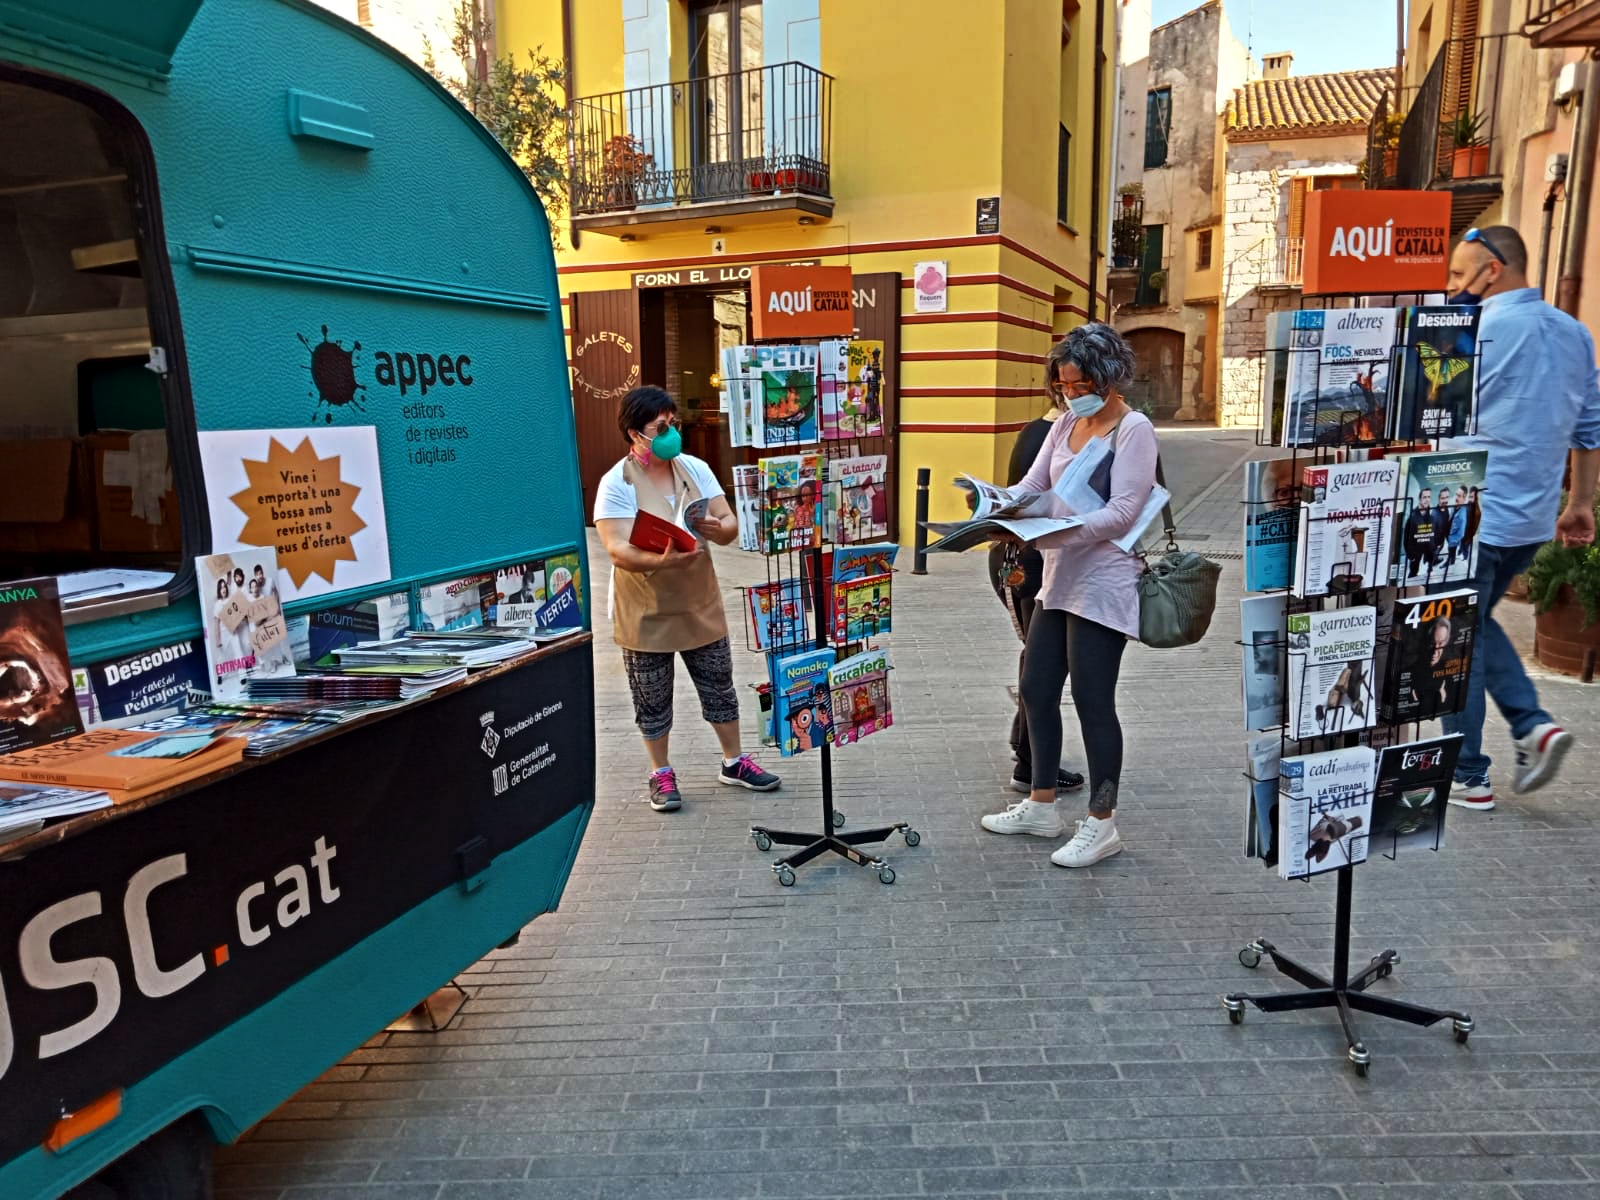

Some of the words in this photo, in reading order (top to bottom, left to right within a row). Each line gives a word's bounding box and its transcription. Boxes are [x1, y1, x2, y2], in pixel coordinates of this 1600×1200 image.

[715, 241, 722, 252] 4
[1329, 218, 1394, 262] AQUÍ
[1395, 227, 1432, 237] REVISTES
[1435, 227, 1445, 237] EN
[1395, 238, 1445, 256] CATALÀ
[635, 272, 680, 287] FORN
[690, 270, 709, 283] EL
[768, 285, 812, 316] AQUÍ
[841, 290, 848, 298] EN
[814, 298, 849, 312] CATALÀ
[1311, 316, 1322, 327] 24
[1337, 312, 1384, 330] alberes
[1417, 312, 1474, 327] Descobrir
[576, 331, 633, 356] GALETES
[374, 351, 473, 396] appec
[572, 364, 640, 399] ARTESANES
[403, 402, 445, 419] editors
[406, 425, 420, 442] de
[424, 424, 469, 440] revistes
[408, 448, 412, 464] i
[415, 446, 456, 467] digitals
[280, 470, 309, 484] Vine
[312, 469, 316, 482] i
[843, 466, 850, 475] el
[852, 462, 881, 473] tatano
[1427, 461, 1472, 474] ENDERROCK
[1314, 474, 1326, 485] 38
[1330, 470, 1395, 493] gavarres
[257, 485, 317, 508] emporta't
[320, 488, 341, 498] una
[271, 506, 305, 520] bossa
[308, 500, 332, 516] amb
[276, 521, 322, 537] revistes
[326, 522, 332, 530] a
[277, 543, 298, 554] eus
[302, 534, 347, 550] d'oferta
[504, 605, 533, 623] alberes
[540, 588, 573, 627] VERTEX
[1405, 598, 1452, 629] 440
[1298, 621, 1308, 631] 26
[1318, 614, 1374, 637] garrotxes
[104, 641, 193, 686] Descobrir
[787, 661, 828, 679] Namaka
[124, 679, 193, 716] Pedraforca
[504, 714, 534, 738] Diputació
[534, 711, 543, 723] de
[542, 701, 564, 717] Girona
[509, 742, 550, 773] Generalitat
[1290, 767, 1302, 776] 29
[1309, 758, 1338, 777] cadí
[511, 774, 521, 787] de
[522, 753, 557, 780] Catalunya
[1318, 788, 1327, 796] LA
[1329, 782, 1363, 794] RETIRADA
